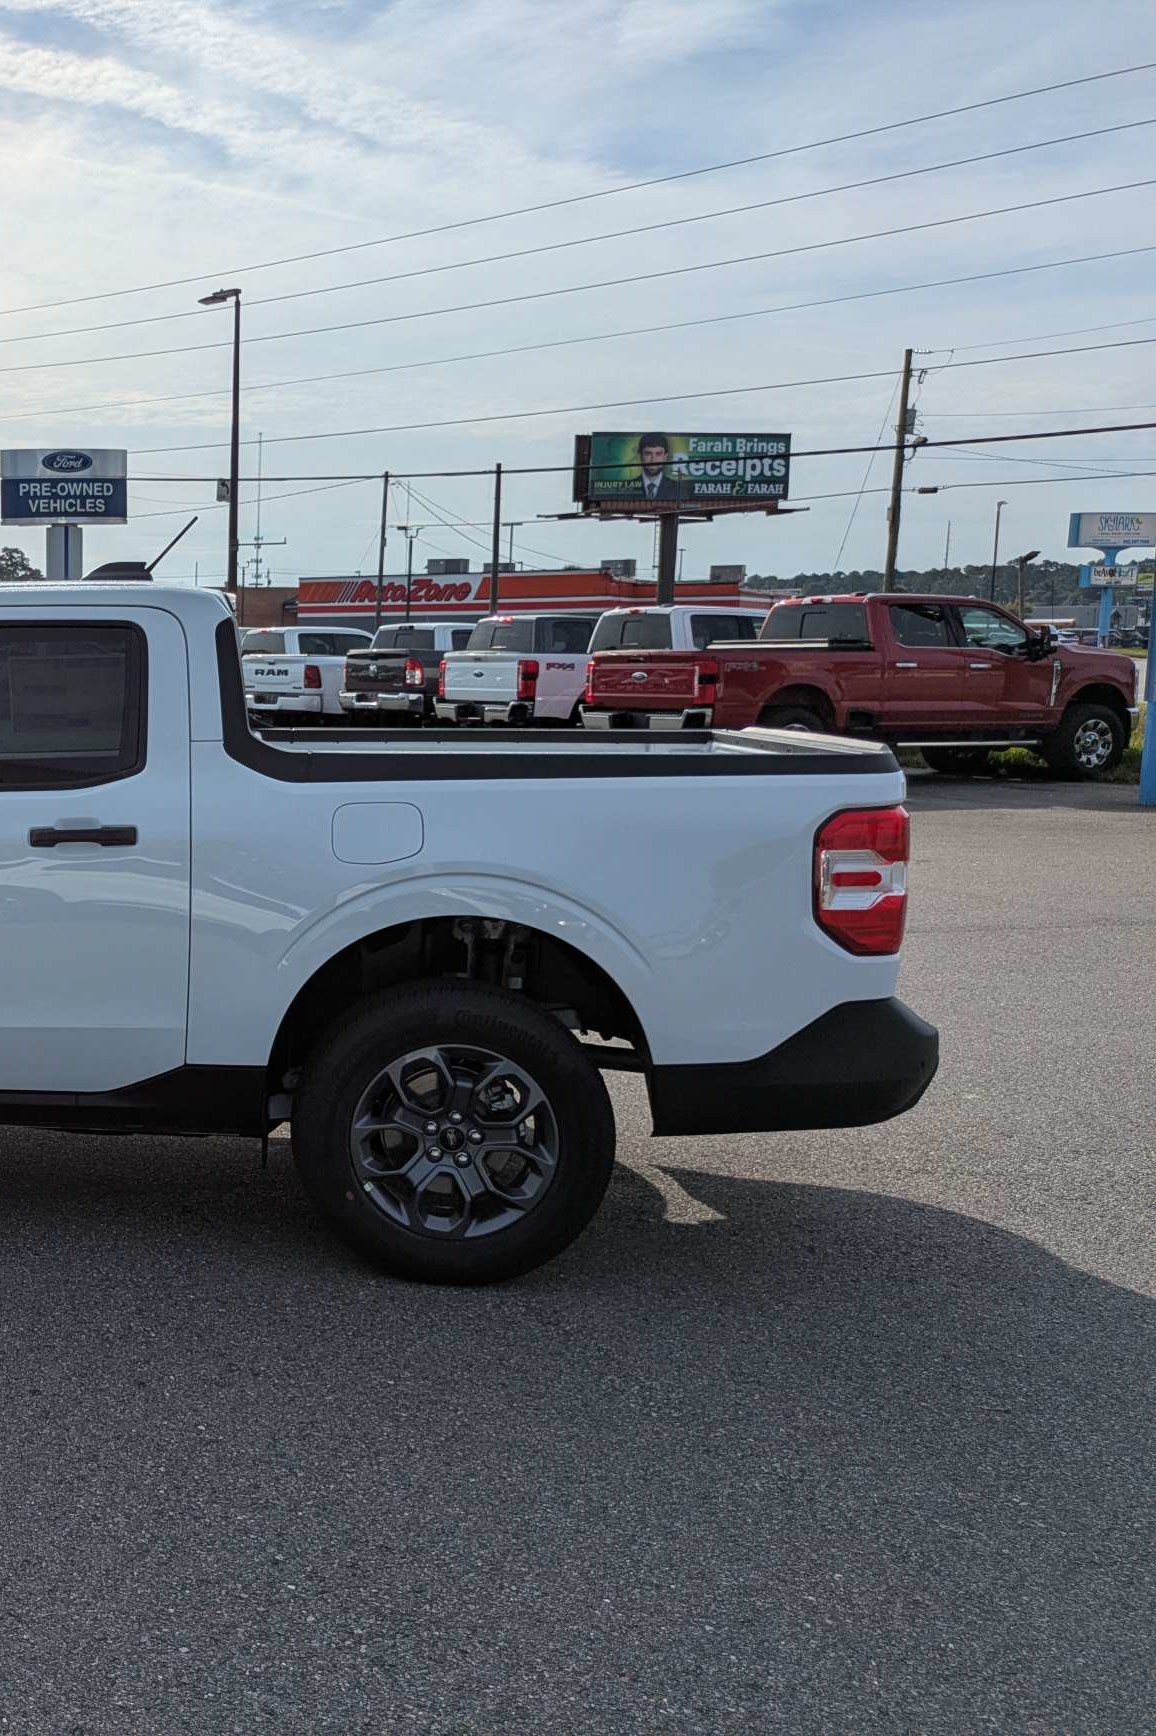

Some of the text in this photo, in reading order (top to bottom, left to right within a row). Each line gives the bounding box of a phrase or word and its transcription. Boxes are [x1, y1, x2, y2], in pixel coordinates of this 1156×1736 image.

[689, 438, 786, 455] Farah Brings
[53, 455, 83, 468] Ford
[671, 453, 786, 482] Receipts
[19, 482, 114, 496] PRE-OWNED
[626, 481, 642, 489] LAW
[694, 483, 732, 495] FARAH
[747, 483, 785, 495] FARAH
[28, 499, 106, 513] VEHICLES
[254, 668, 289, 677] RAM
